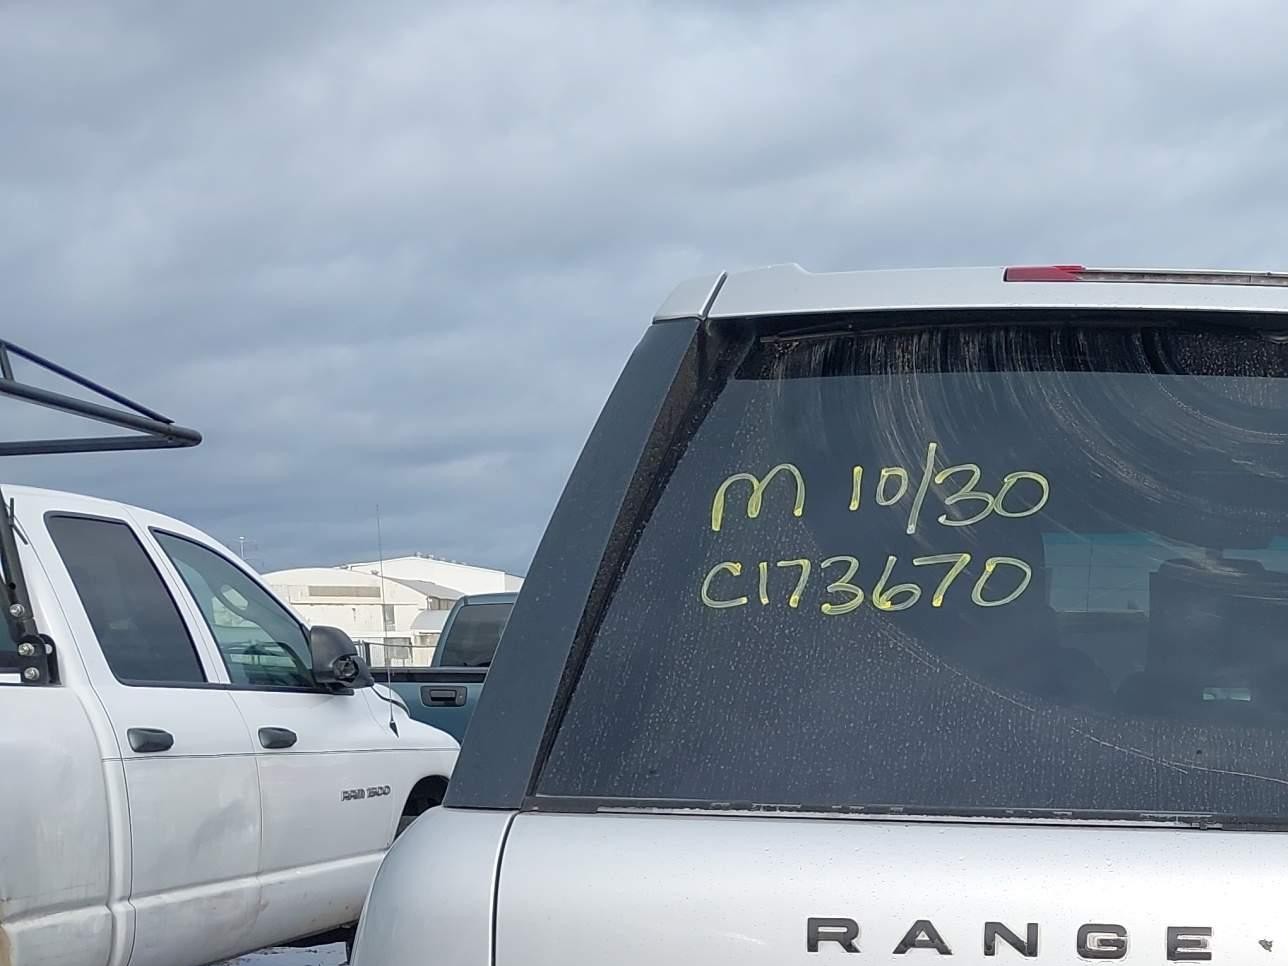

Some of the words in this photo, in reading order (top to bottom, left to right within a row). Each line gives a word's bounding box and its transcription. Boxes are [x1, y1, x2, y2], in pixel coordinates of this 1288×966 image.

[848, 442, 1050, 534] 10/30
[700, 553, 1032, 615] C173670
[806, 917, 1213, 961] RANGE
